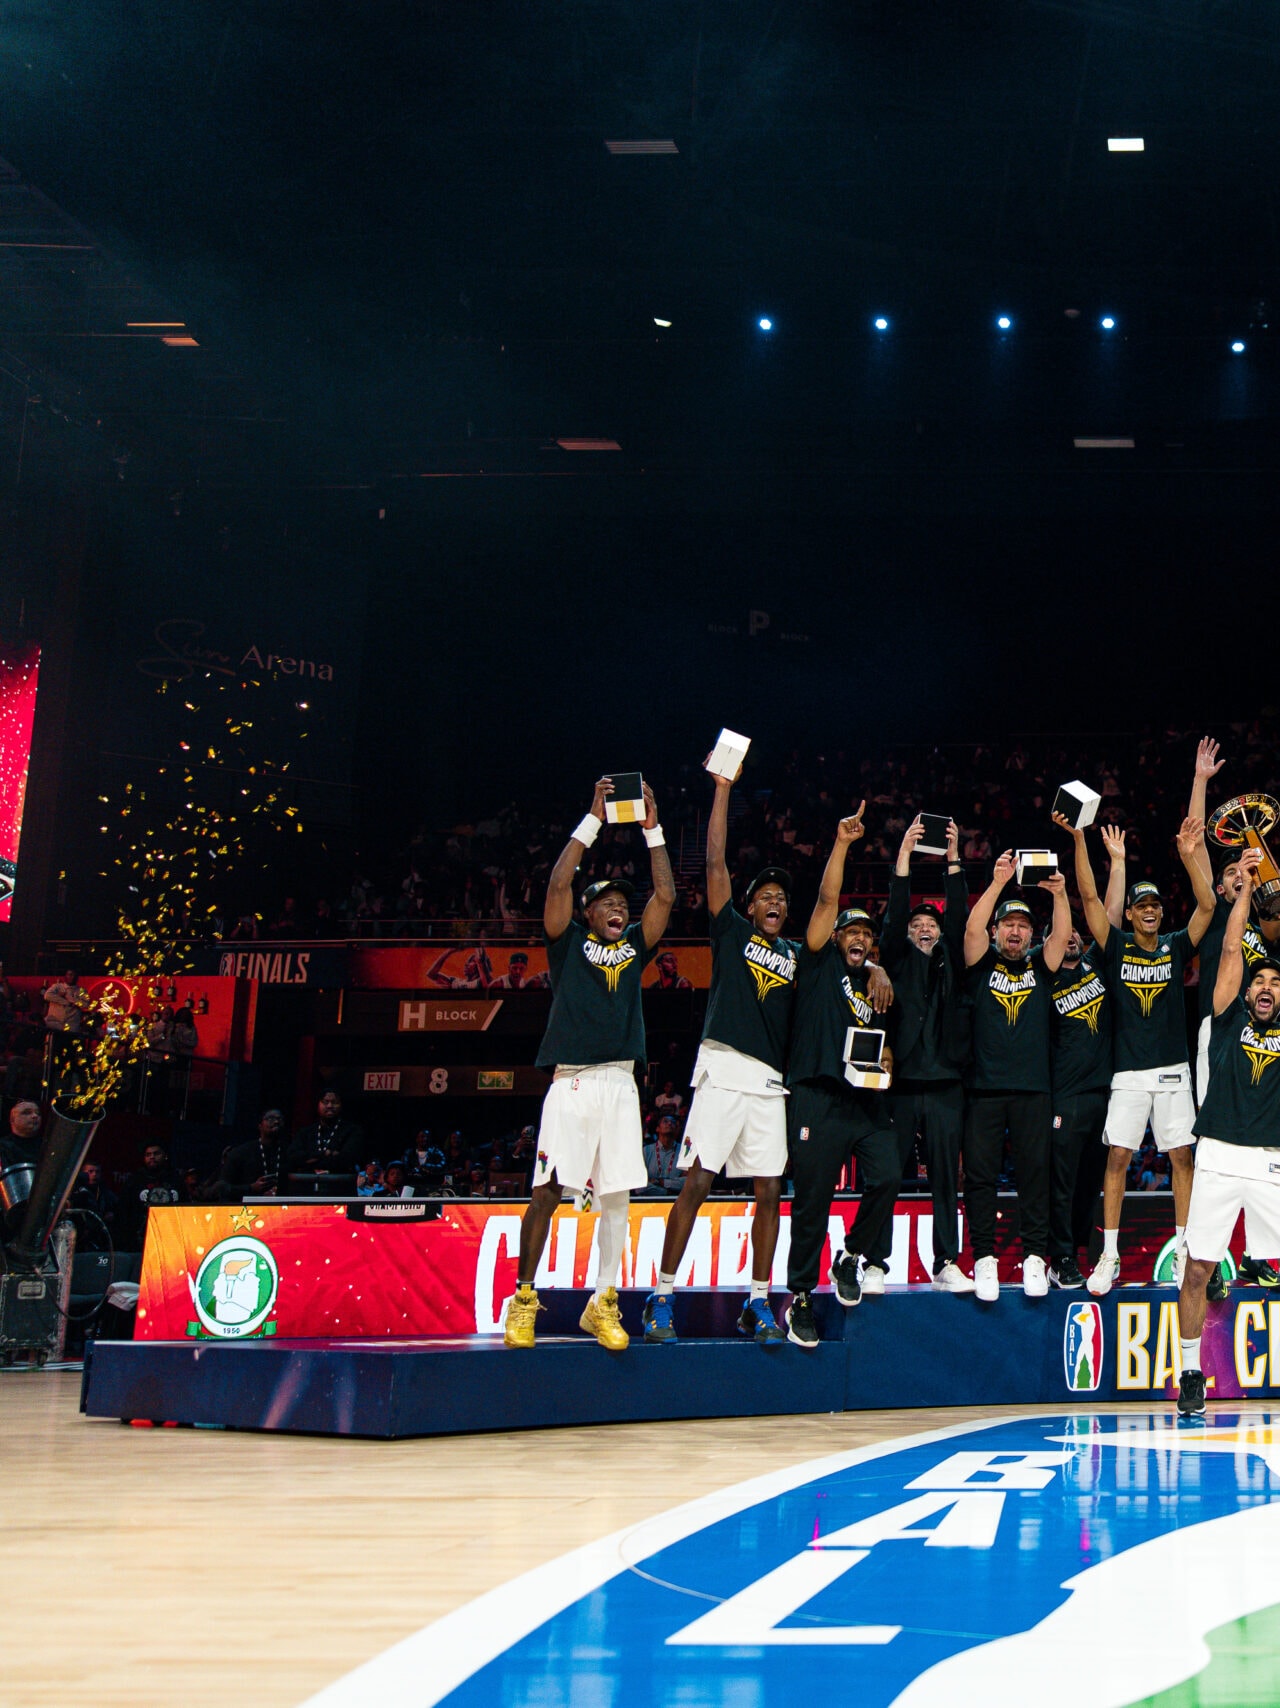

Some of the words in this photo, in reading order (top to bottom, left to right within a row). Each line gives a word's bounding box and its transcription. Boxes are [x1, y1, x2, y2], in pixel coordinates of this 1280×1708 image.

[748, 609, 770, 637] P
[240, 644, 334, 682] Arena
[583, 940, 637, 967] CHAMIONS
[236, 952, 311, 984] FINALS
[1121, 963, 1172, 983] CHAMPIONS
[1055, 977, 1106, 1015] CHAMPIONS
[402, 1002, 426, 1029] H
[435, 1010, 477, 1021] BLOCK
[367, 1073, 397, 1089] EXIT
[428, 1067, 449, 1094] 8
[223, 1327, 241, 1335] 1950
[1068, 1324, 1076, 1367] BAL
[1117, 1302, 1216, 1390] BA
[665, 1450, 1078, 1646] BAL
